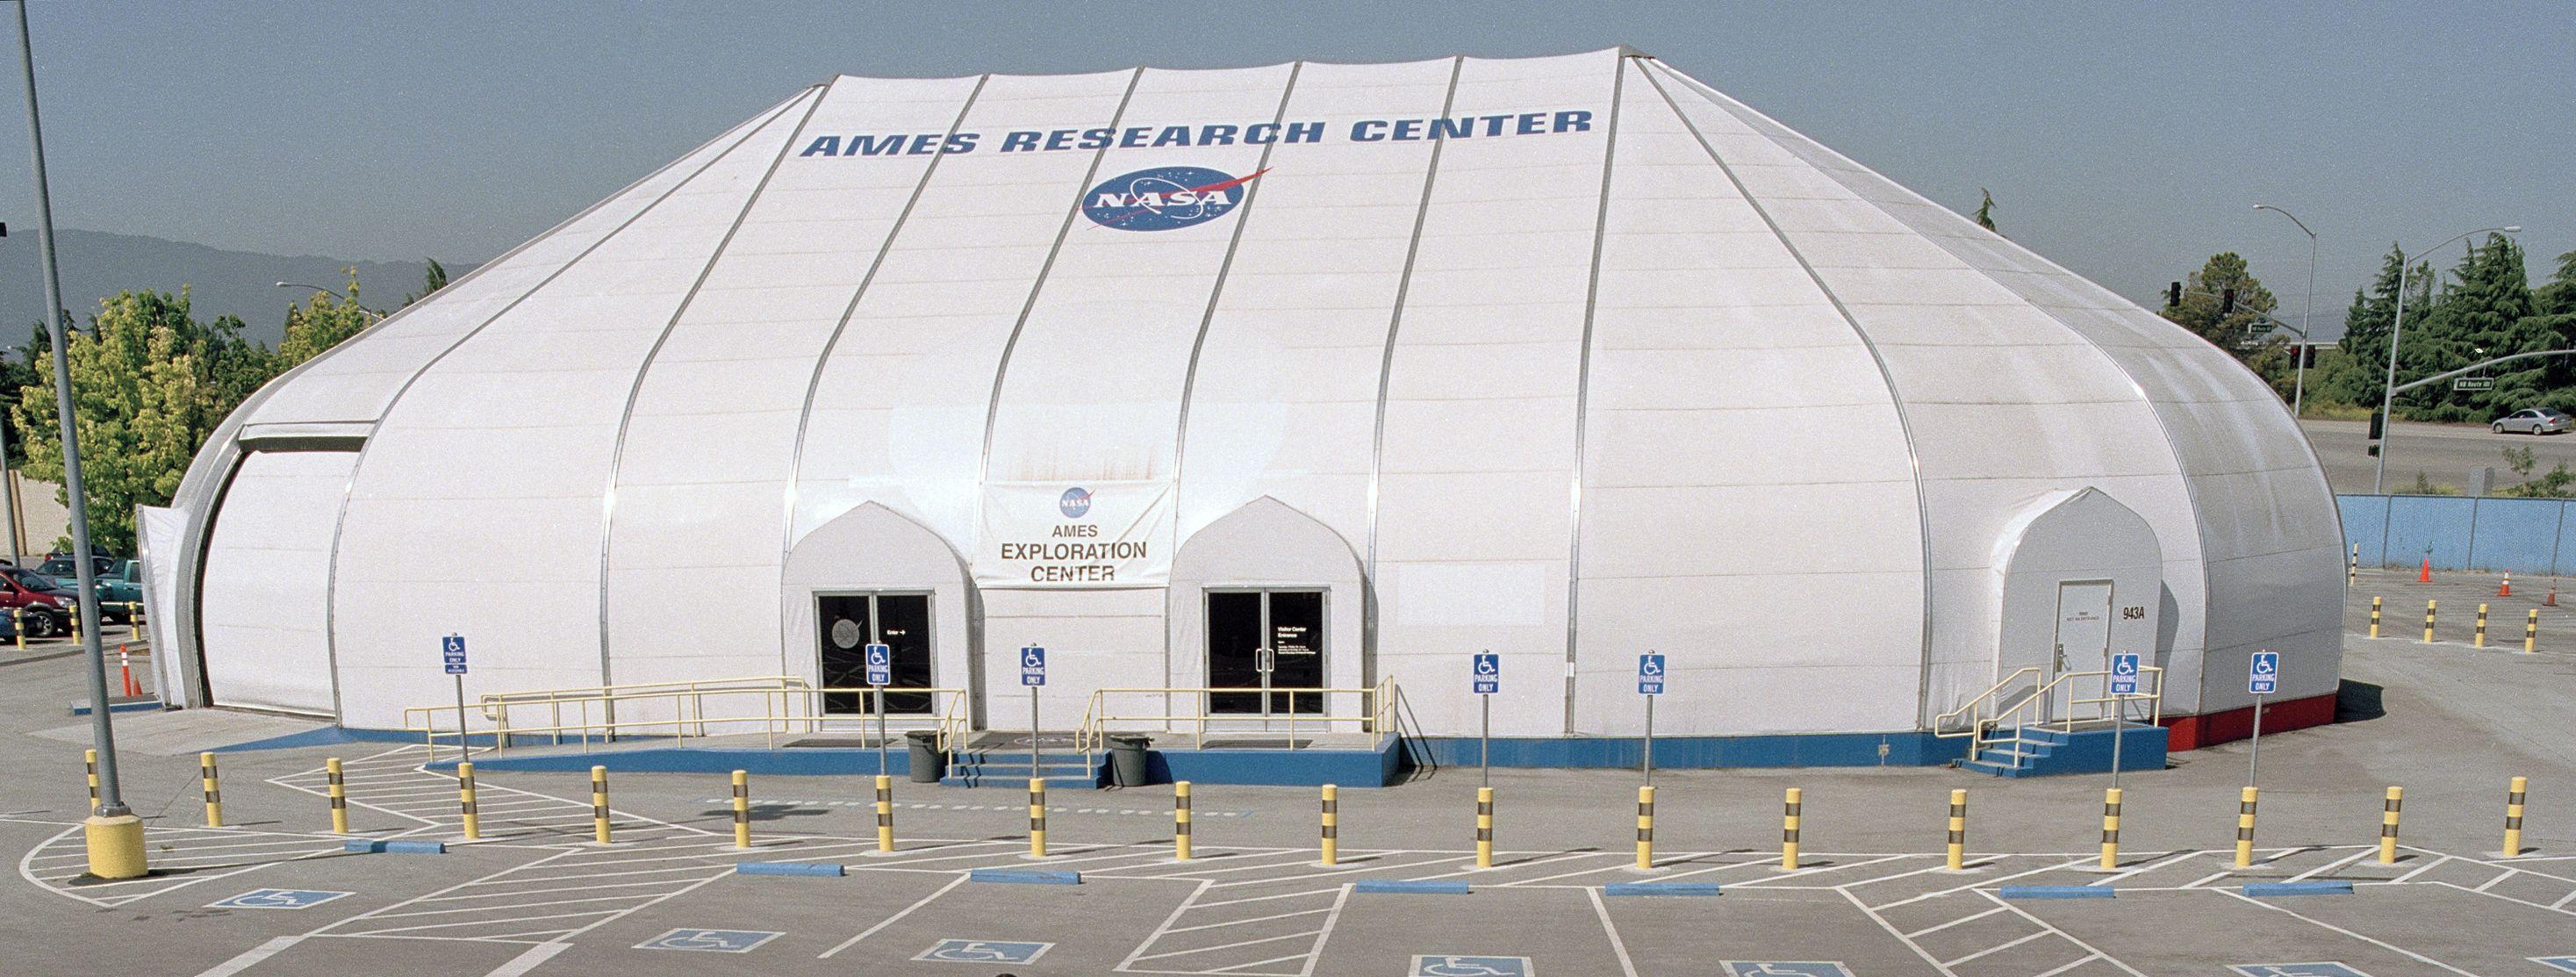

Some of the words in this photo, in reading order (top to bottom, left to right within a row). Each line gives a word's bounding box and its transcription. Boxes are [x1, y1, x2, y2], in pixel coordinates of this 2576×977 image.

[800, 133, 980, 157] AMES
[1000, 122, 1326, 153] RESEARCH
[1349, 111, 1592, 142] CENTER
[1094, 190, 1231, 208] NASA
[1061, 499, 1090, 507] NASA
[1051, 524, 1098, 537] AMES
[1001, 542, 1147, 560] EXPLORATION
[1030, 564, 1116, 582] CENTER
[2123, 607, 2145, 620] 943A
[868, 665, 888, 673] PARKING
[872, 673, 885, 682] ONLY
[2113, 674, 2135, 683] PARKING
[1478, 683, 1493, 692] ONLY
[1643, 684, 1658, 693] ONLY
[2116, 683, 2131, 692] ONLY
[2256, 682, 2270, 691] ONLY
